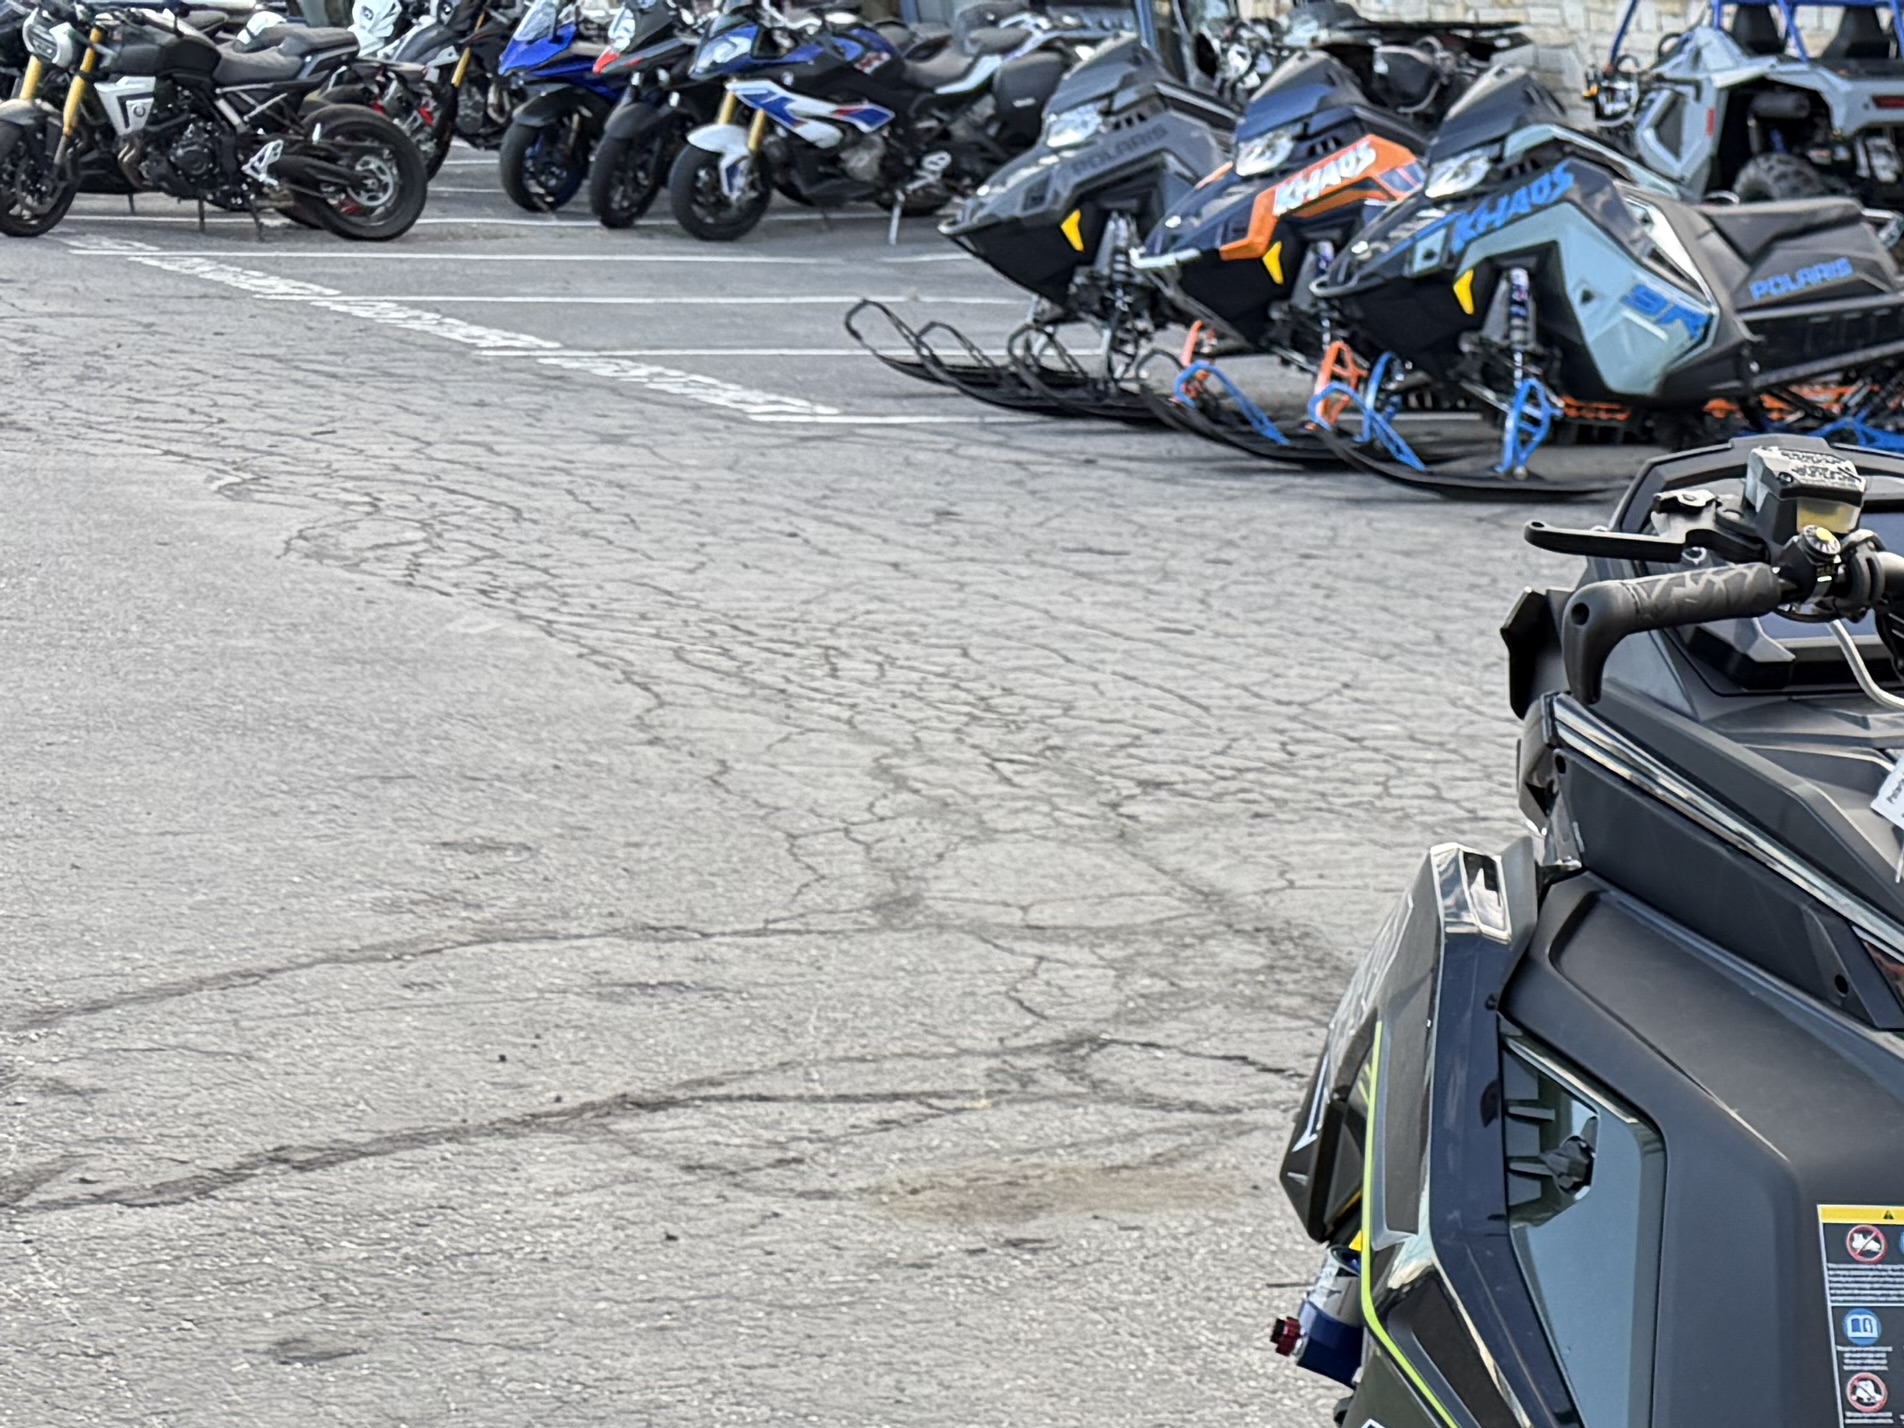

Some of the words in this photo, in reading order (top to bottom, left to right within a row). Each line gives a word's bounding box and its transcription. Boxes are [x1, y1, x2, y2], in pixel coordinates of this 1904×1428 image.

[1273, 140, 1376, 217] KHAOS
[1452, 159, 1574, 254] KHAOS
[1749, 257, 1853, 301] POLARIS
